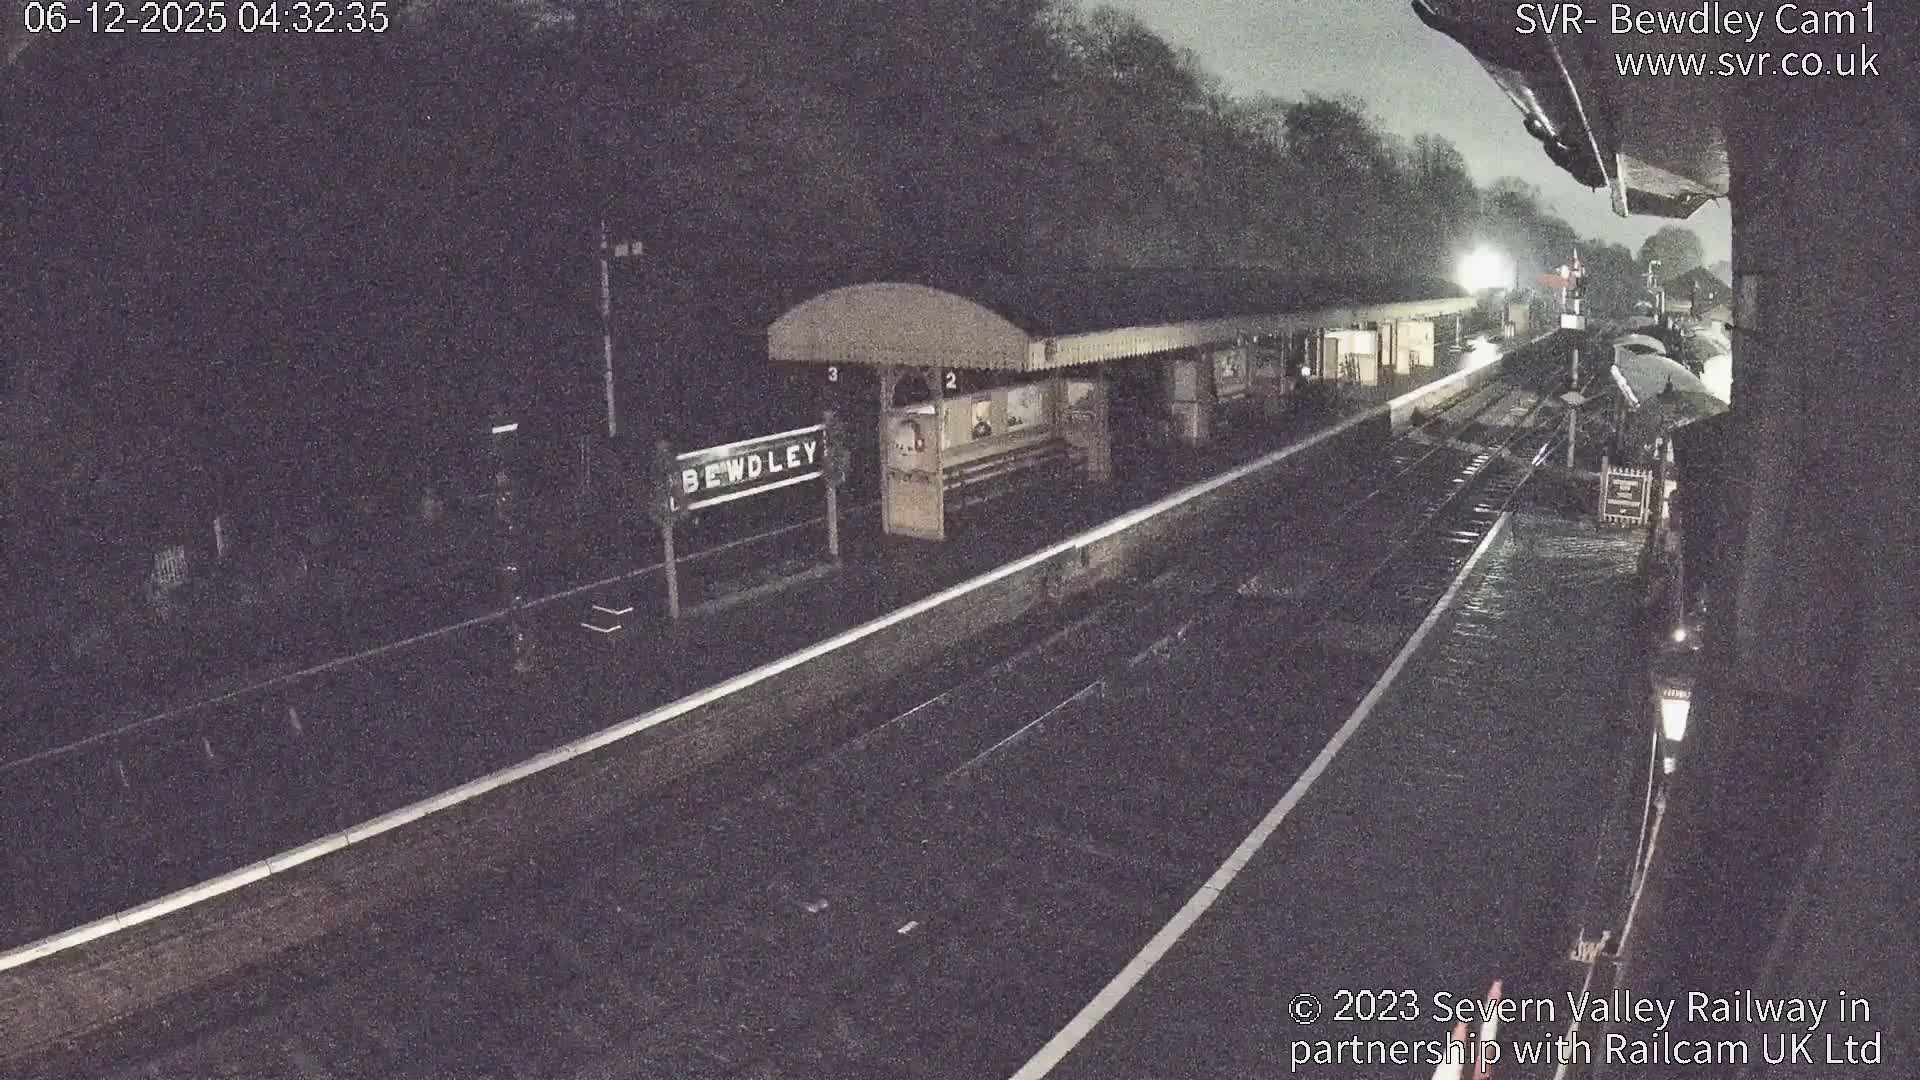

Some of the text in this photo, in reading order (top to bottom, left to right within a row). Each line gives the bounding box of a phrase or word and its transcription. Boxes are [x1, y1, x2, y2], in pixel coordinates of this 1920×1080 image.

[828, 367, 838, 382] 3
[946, 372, 957, 389] 2
[682, 440, 817, 494] BEWDLEY
